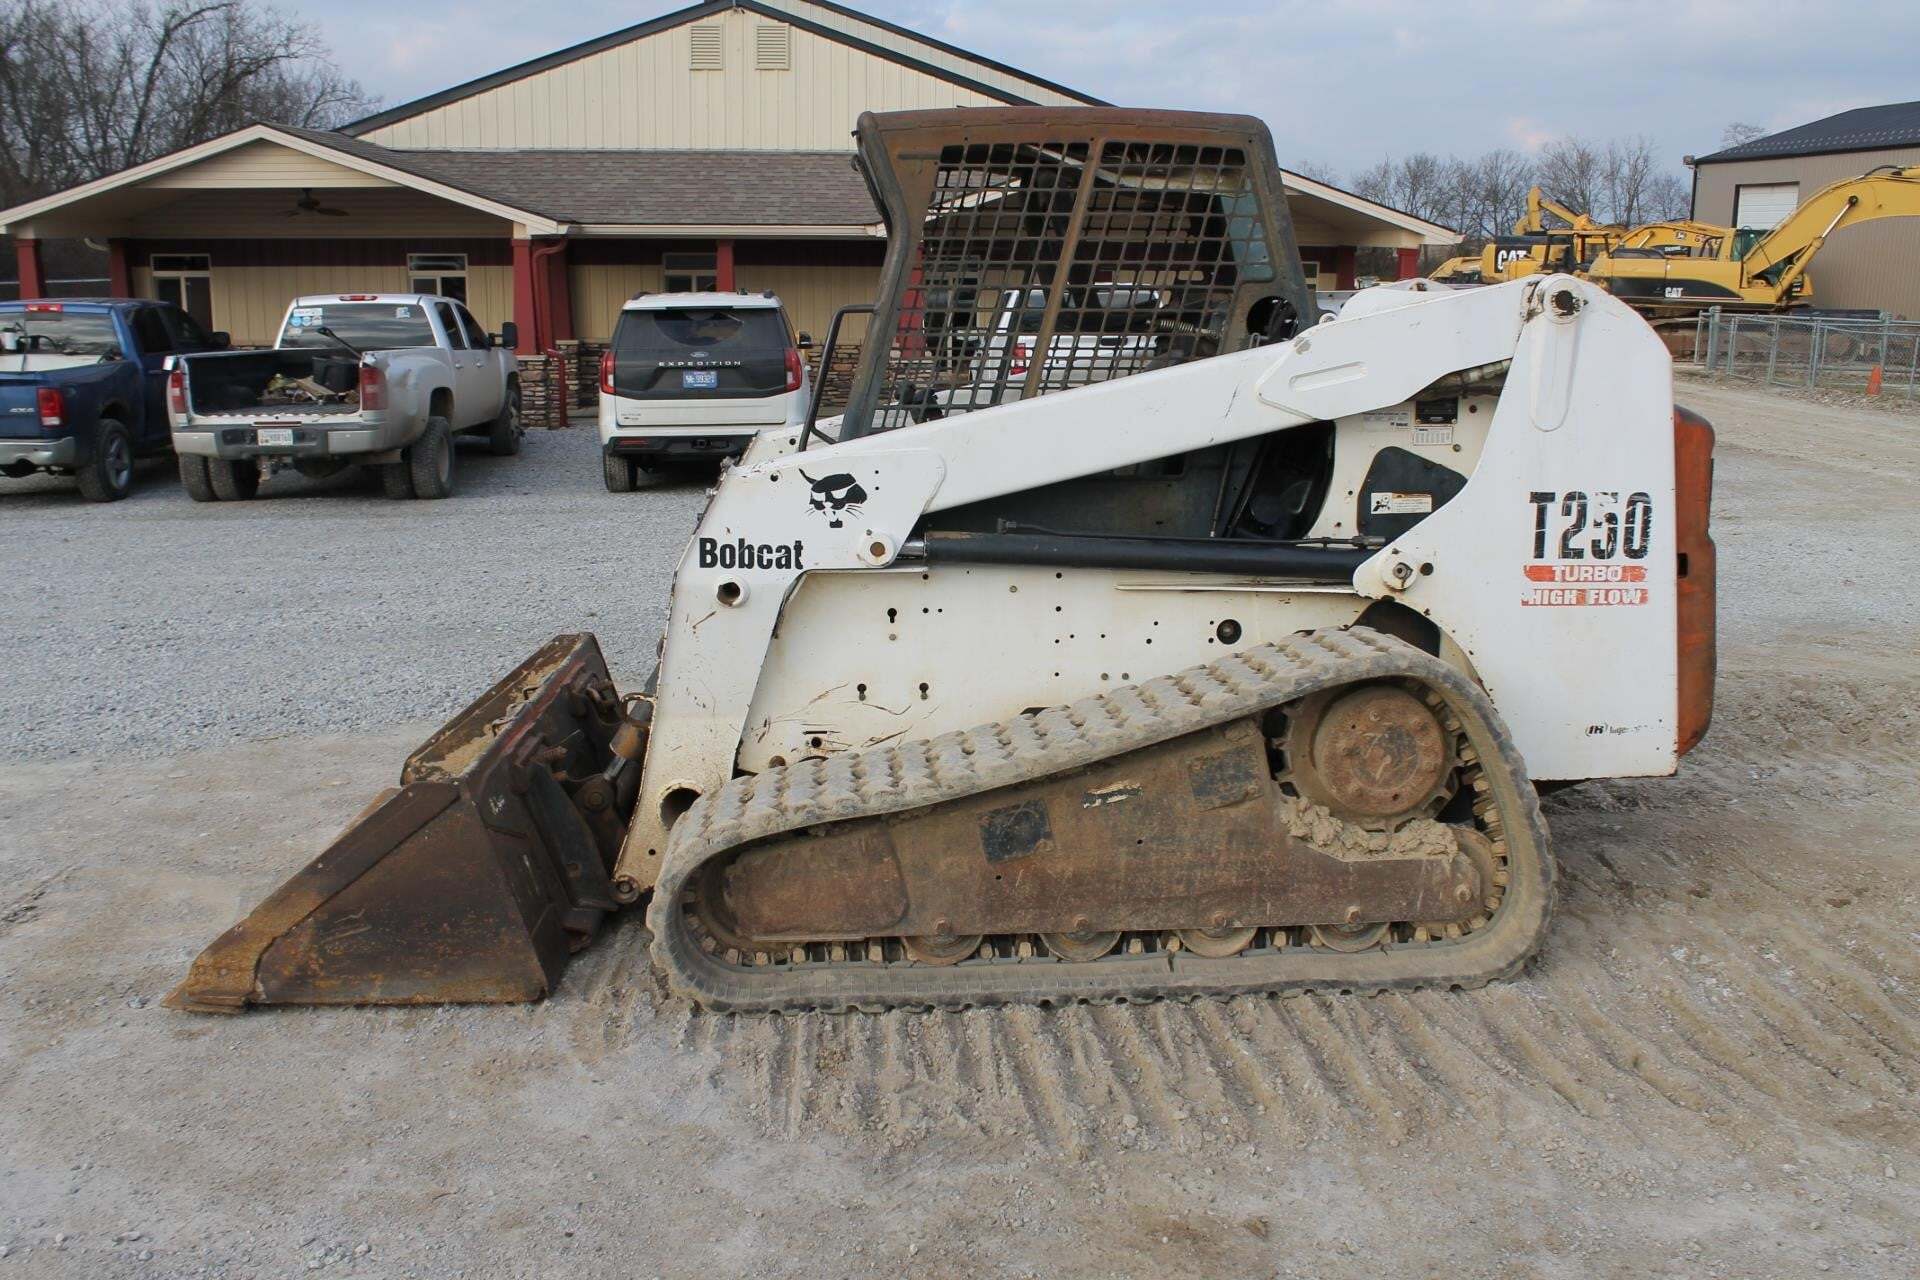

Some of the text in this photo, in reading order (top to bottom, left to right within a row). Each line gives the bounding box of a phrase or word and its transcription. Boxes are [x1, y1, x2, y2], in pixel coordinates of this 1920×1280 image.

[1665, 286, 1684, 298] CAT
[1528, 491, 1652, 560] T250
[699, 537, 804, 569] Bobcat
[1552, 565, 1623, 582] TURBO
[1528, 589, 1642, 605] HIGH FLOW
